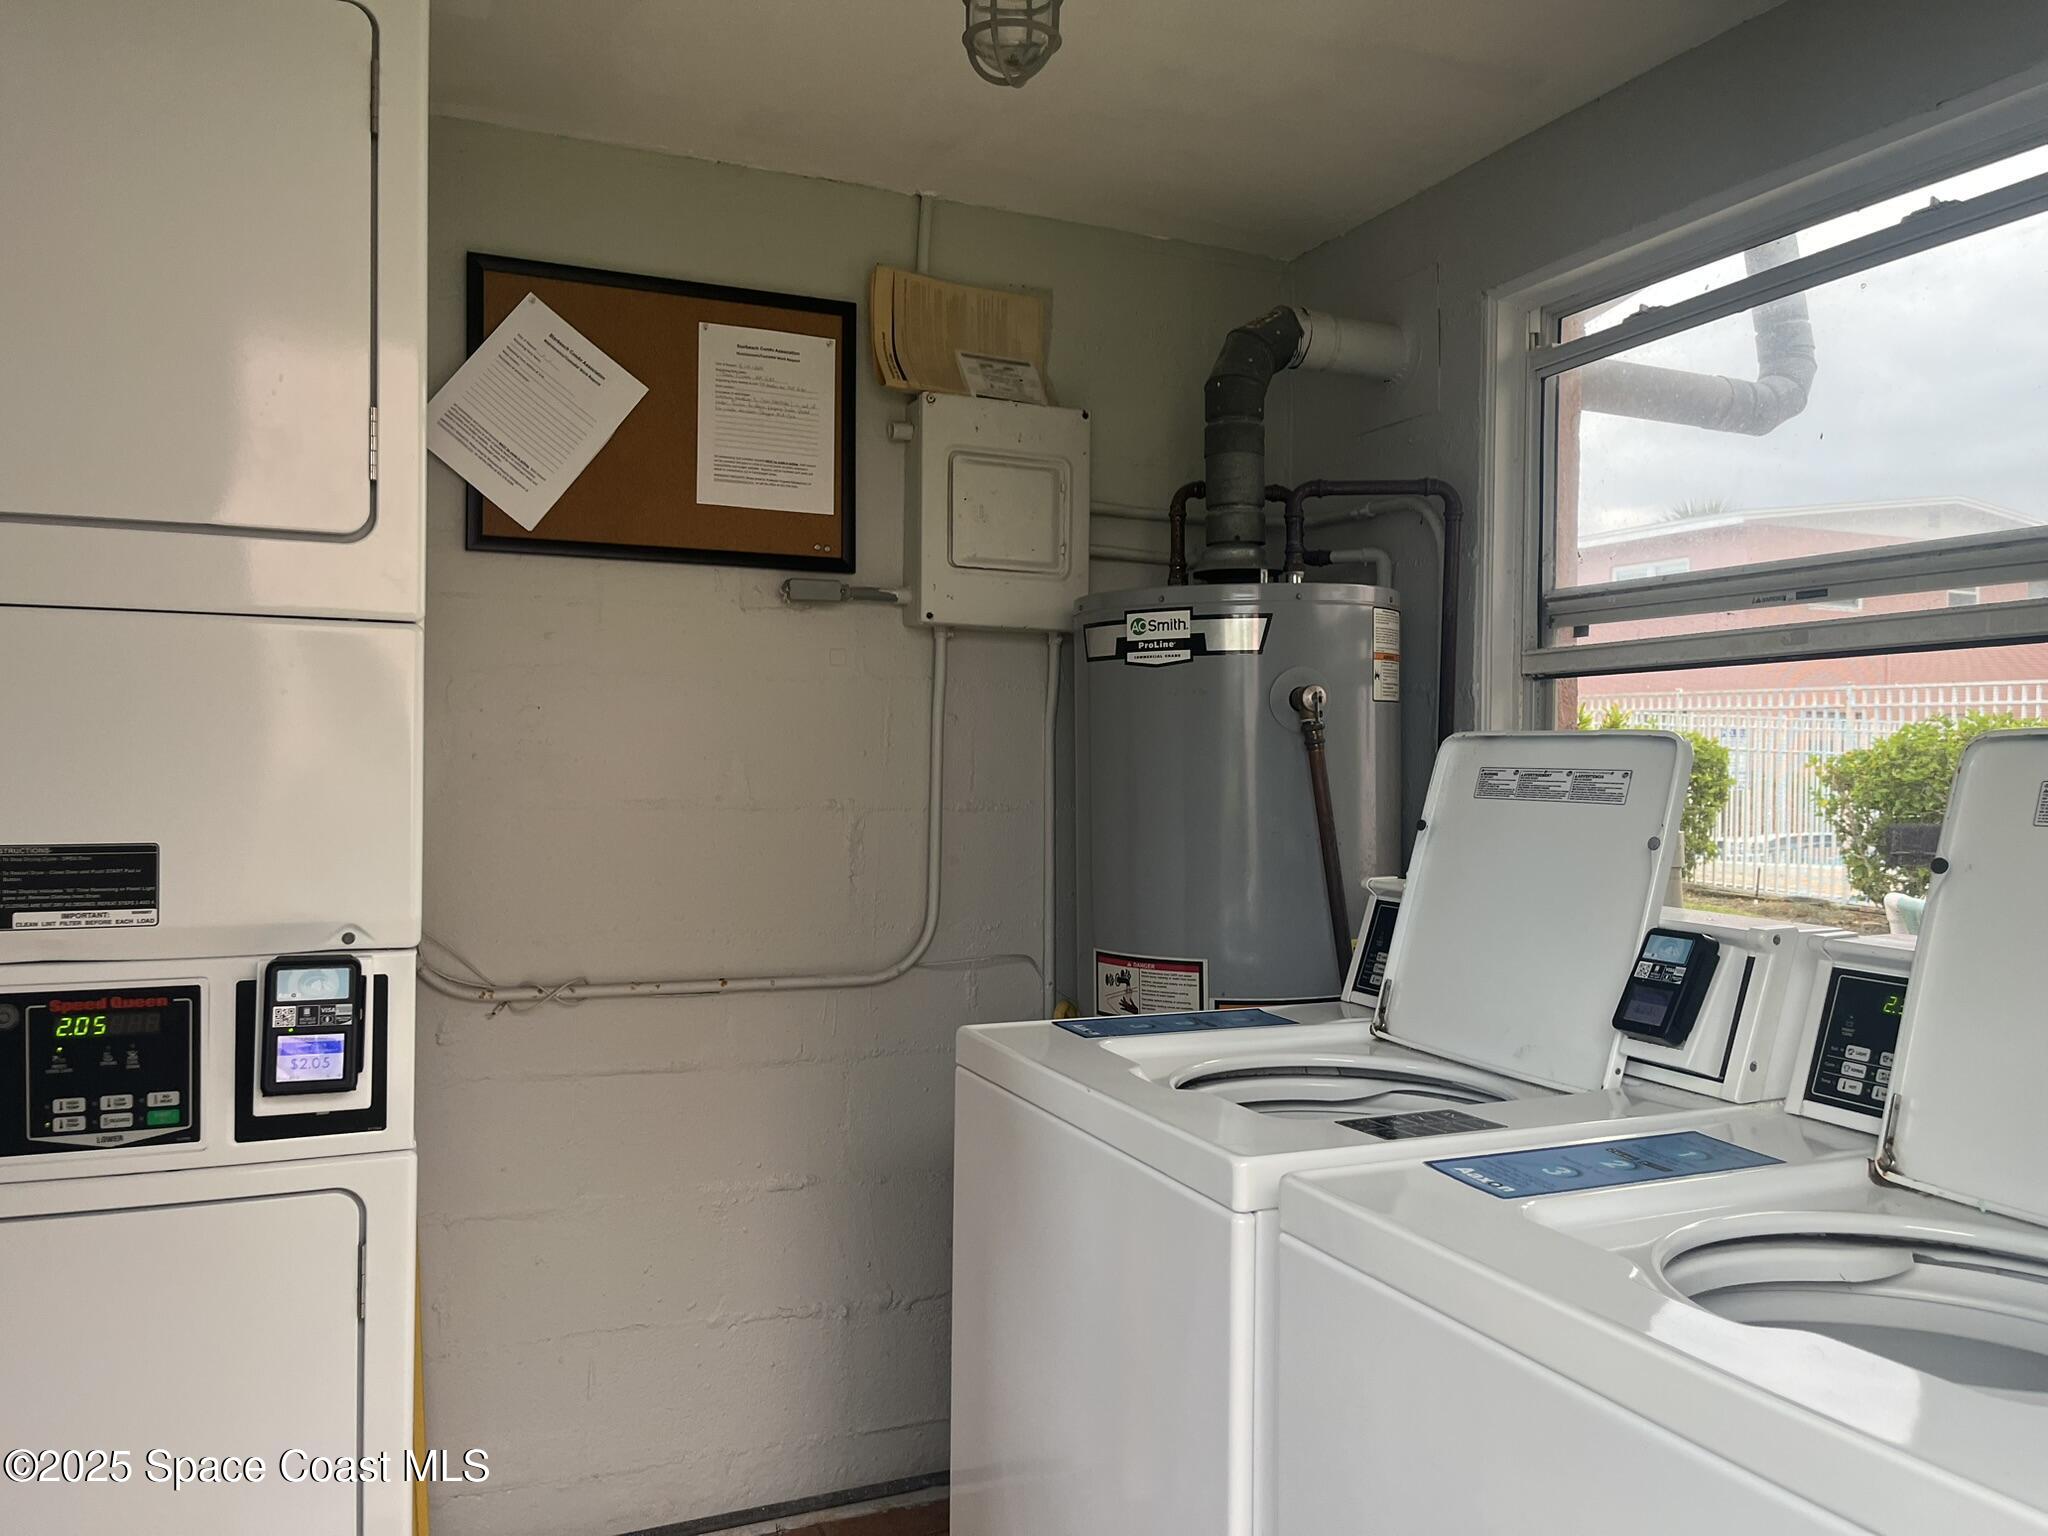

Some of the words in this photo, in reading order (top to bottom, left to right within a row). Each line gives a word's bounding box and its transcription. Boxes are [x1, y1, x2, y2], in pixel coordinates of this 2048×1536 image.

[1138, 641, 1175, 649] ProLine
[59, 919, 82, 927] FILTER
[49, 997, 107, 1014] Speed
[111, 996, 169, 1009] Queen
[320, 1006, 336, 1014] VISA
[55, 1015, 107, 1037] 2.05
[290, 1056, 331, 1070] $2.05
[95, 1134, 124, 1144] LOWER
[1542, 1166, 1572, 1176] 3
